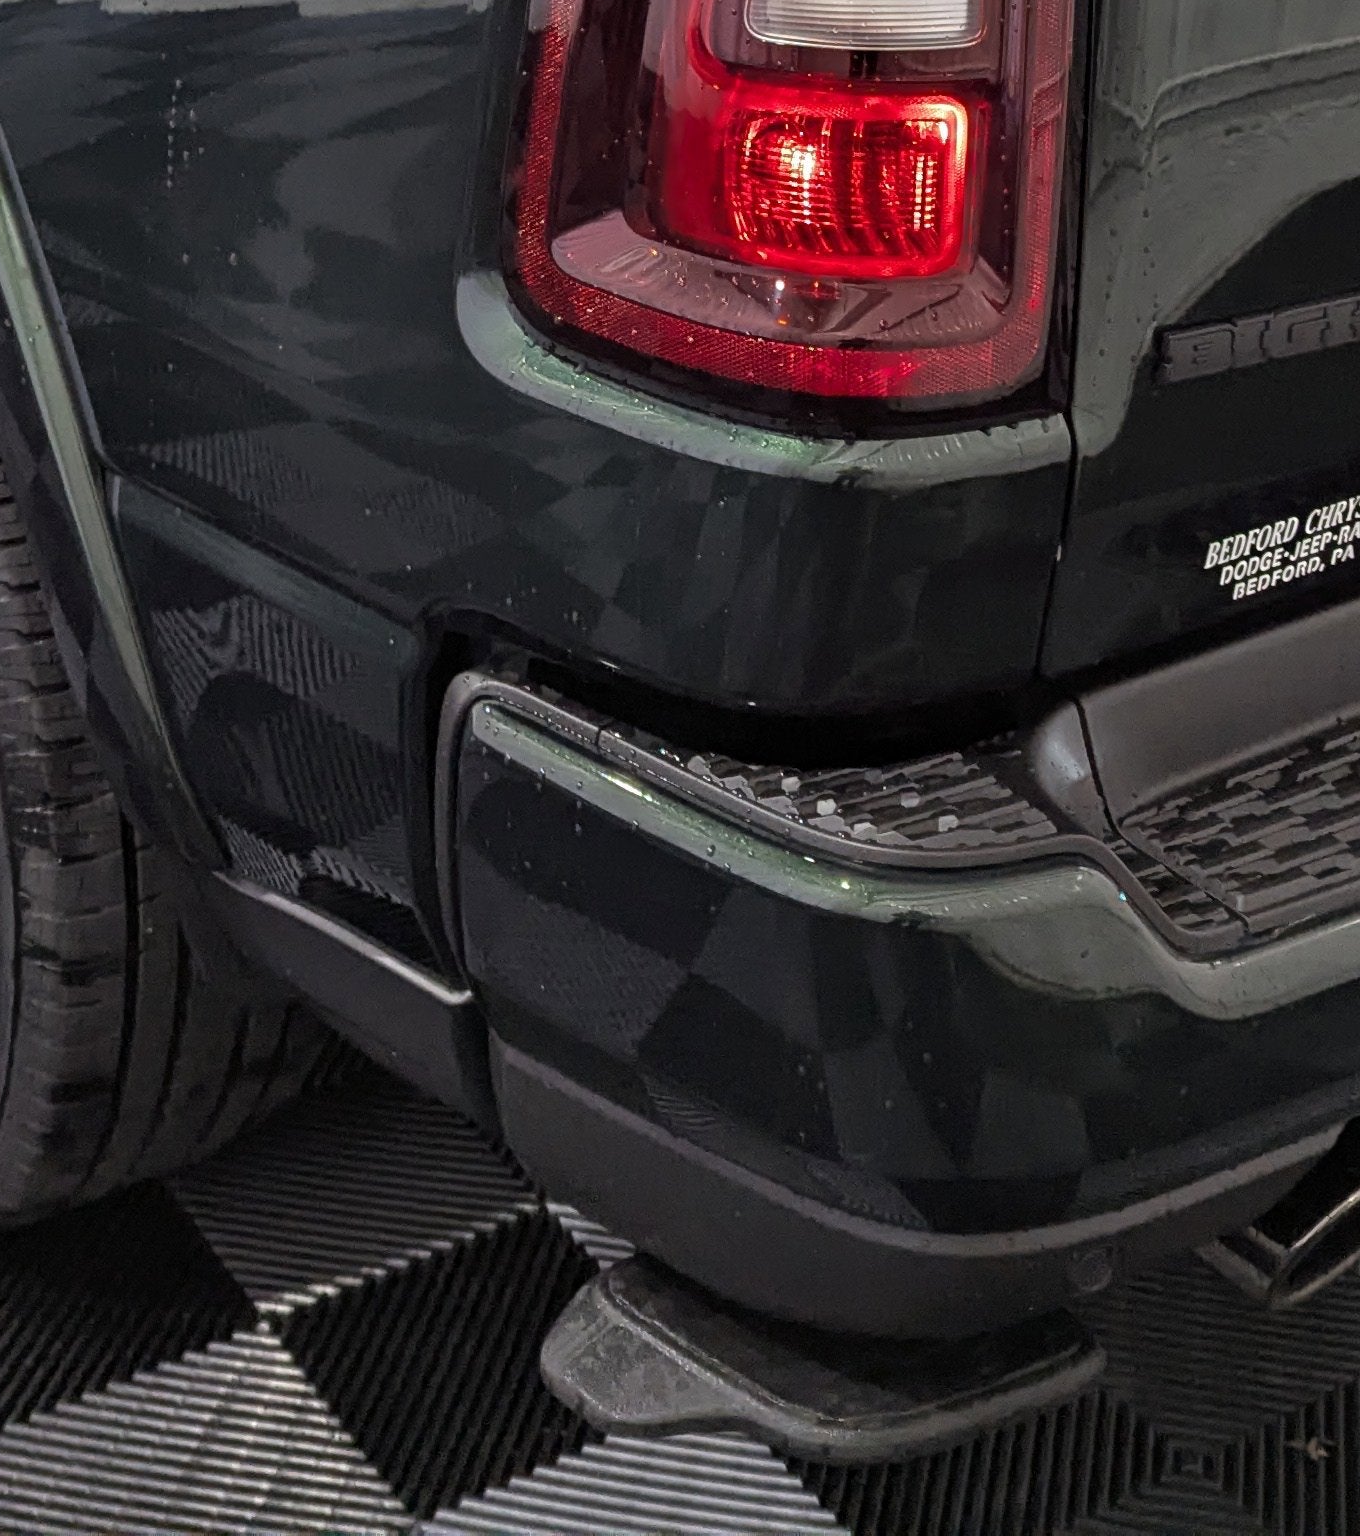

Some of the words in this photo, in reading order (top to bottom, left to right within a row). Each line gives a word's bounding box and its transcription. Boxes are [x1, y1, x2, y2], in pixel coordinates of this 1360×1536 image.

[1203, 516, 1300, 570] BEDFORD
[1232, 556, 1326, 601] BEDFORD,
[1330, 544, 1356, 566] PA
